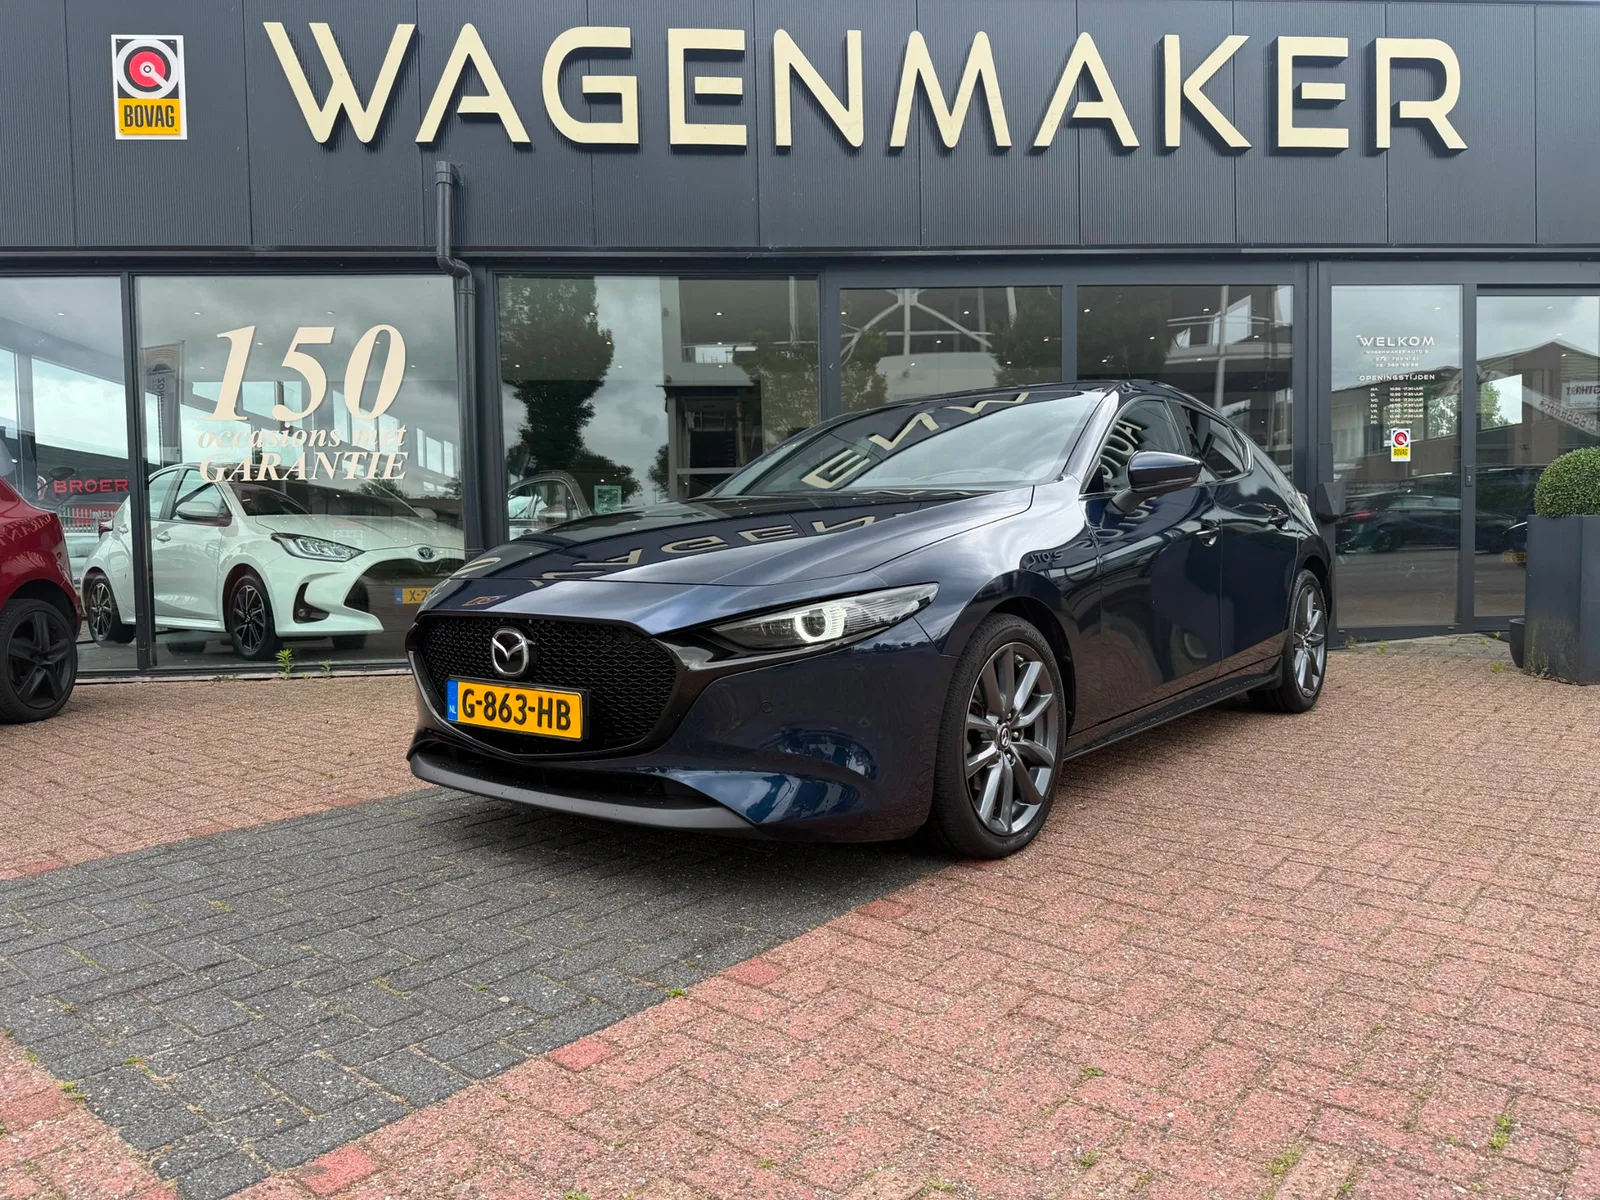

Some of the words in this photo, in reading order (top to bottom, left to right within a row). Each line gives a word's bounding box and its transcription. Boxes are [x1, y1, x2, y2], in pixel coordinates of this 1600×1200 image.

[262, 22, 1469, 151] WAGENMAKER
[124, 105, 176, 129] BOVAG
[1360, 336, 1435, 347] WELKOM
[200, 324, 406, 422] 150
[198, 421, 342, 448] occasions
[353, 424, 408, 448] met
[200, 451, 409, 482] GARANTIE
[53, 479, 129, 493] BROER
[461, 688, 571, 730] G-863-HB
